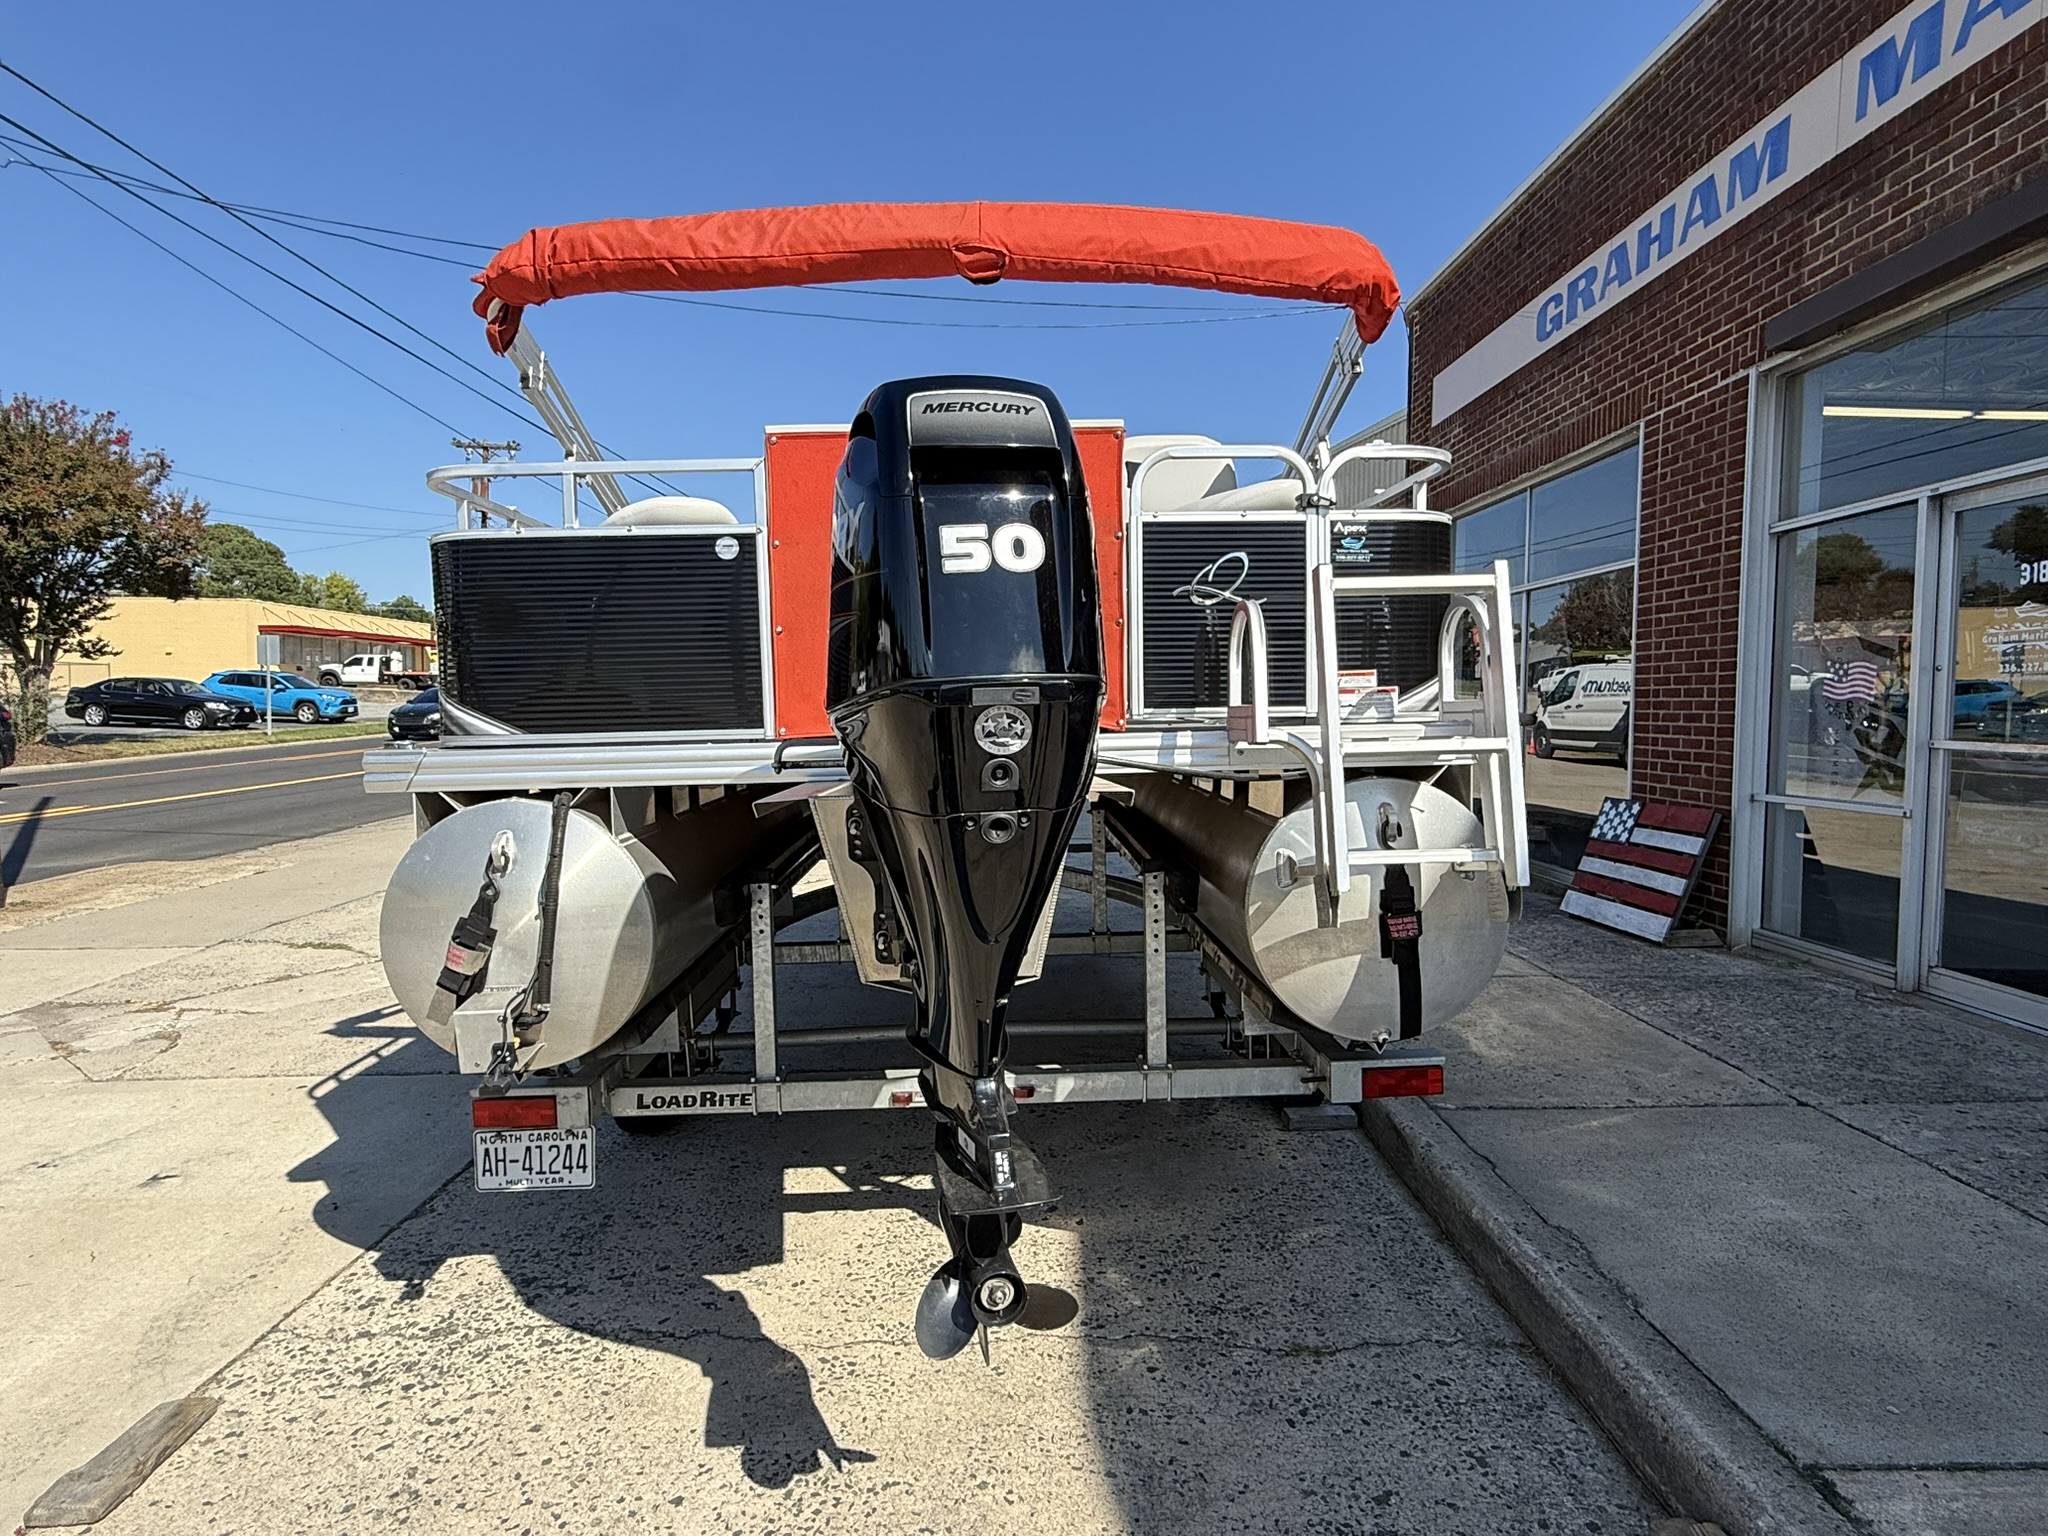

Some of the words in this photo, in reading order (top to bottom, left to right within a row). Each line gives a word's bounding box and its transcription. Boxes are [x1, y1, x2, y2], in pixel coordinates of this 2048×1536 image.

[1536, 114, 1791, 342] GRAHAM
[922, 402, 1036, 415] MERCURY
[1333, 521, 1367, 535] Apex
[939, 523, 1046, 574] 50
[1982, 634, 2019, 643] Graham
[480, 1134, 522, 1145] NORTH
[482, 1143, 588, 1178] AH-41244
[505, 1178, 533, 1186] MULTI
[539, 1177, 564, 1185] YEAR
